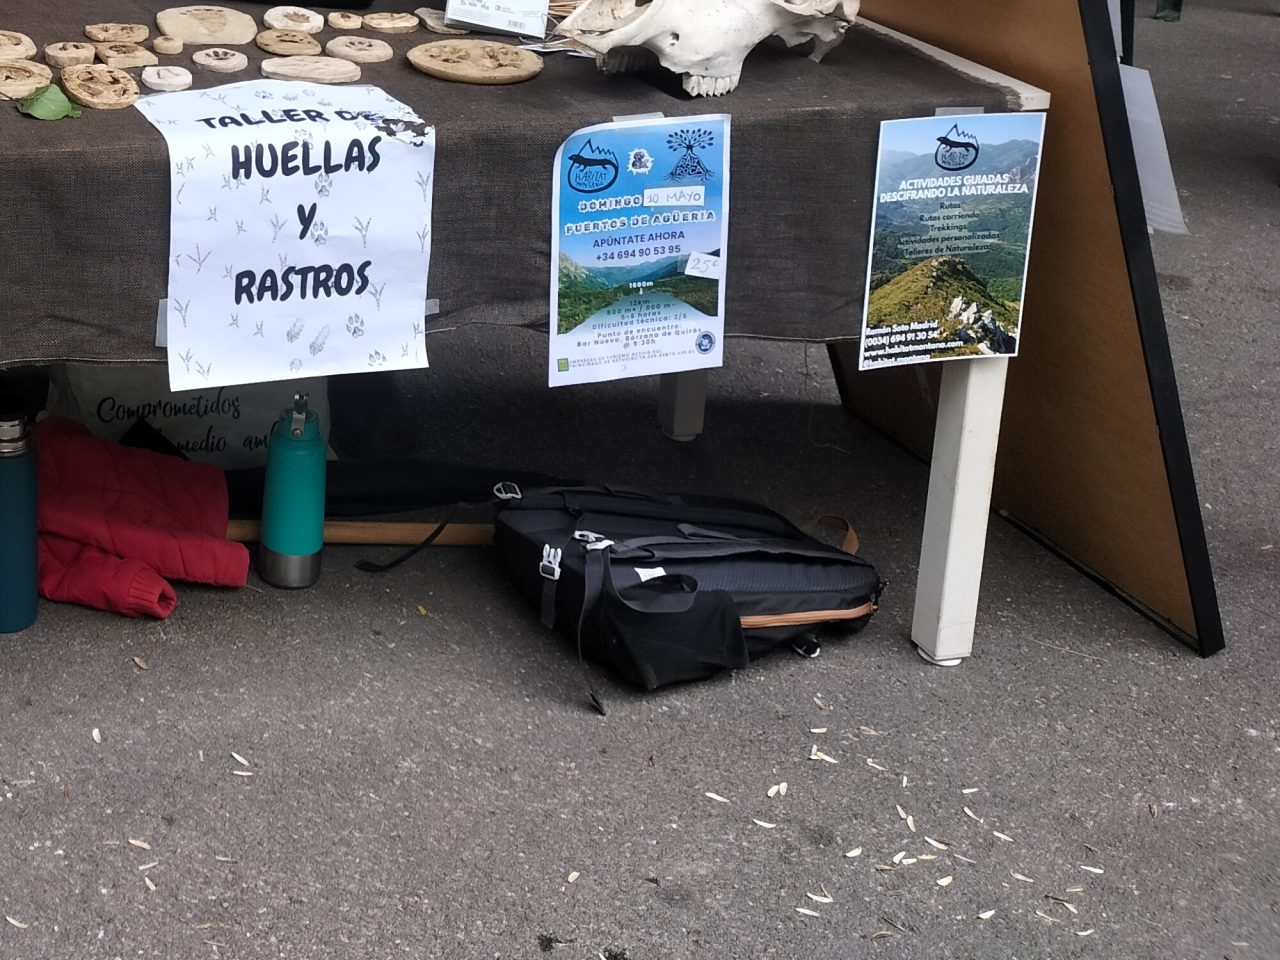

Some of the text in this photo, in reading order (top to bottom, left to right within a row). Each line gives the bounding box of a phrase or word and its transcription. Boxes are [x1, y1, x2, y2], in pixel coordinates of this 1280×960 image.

[197, 109, 329, 129] TALLER
[231, 136, 382, 180] HUELLAS
[676, 165, 705, 176] ROCA
[899, 174, 1010, 190] ACTIVIDADES GUIADAS
[580, 196, 642, 211] DOMINGO
[666, 190, 701, 203] MAYO
[880, 184, 1029, 203] DESCIFRANDO LA NATURALEZA
[939, 202, 961, 210] Rutas
[296, 202, 317, 241] Y
[566, 220, 627, 234] PUERTOS
[632, 215, 648, 226] DE
[920, 212, 981, 222] Rutas corriendo
[930, 223, 968, 233] Trekkings
[592, 230, 685, 249] APÚNTATE AHORA
[941, 231, 1001, 244] personalizadas
[596, 244, 681, 262] +34 694 90 53 95
[904, 243, 989, 256] Talleres de Naturaleza
[234, 260, 372, 305] RASTROS
[592, 320, 635, 331] Dificultad
[597, 330, 621, 339] Punto
[892, 324, 909, 333] Soto
[910, 319, 938, 330] Madrid
[865, 336, 890, 349] (0034)
[890, 334, 906, 343] 694
[916, 331, 927, 340] 30
[96, 387, 242, 424] Comprometidos
